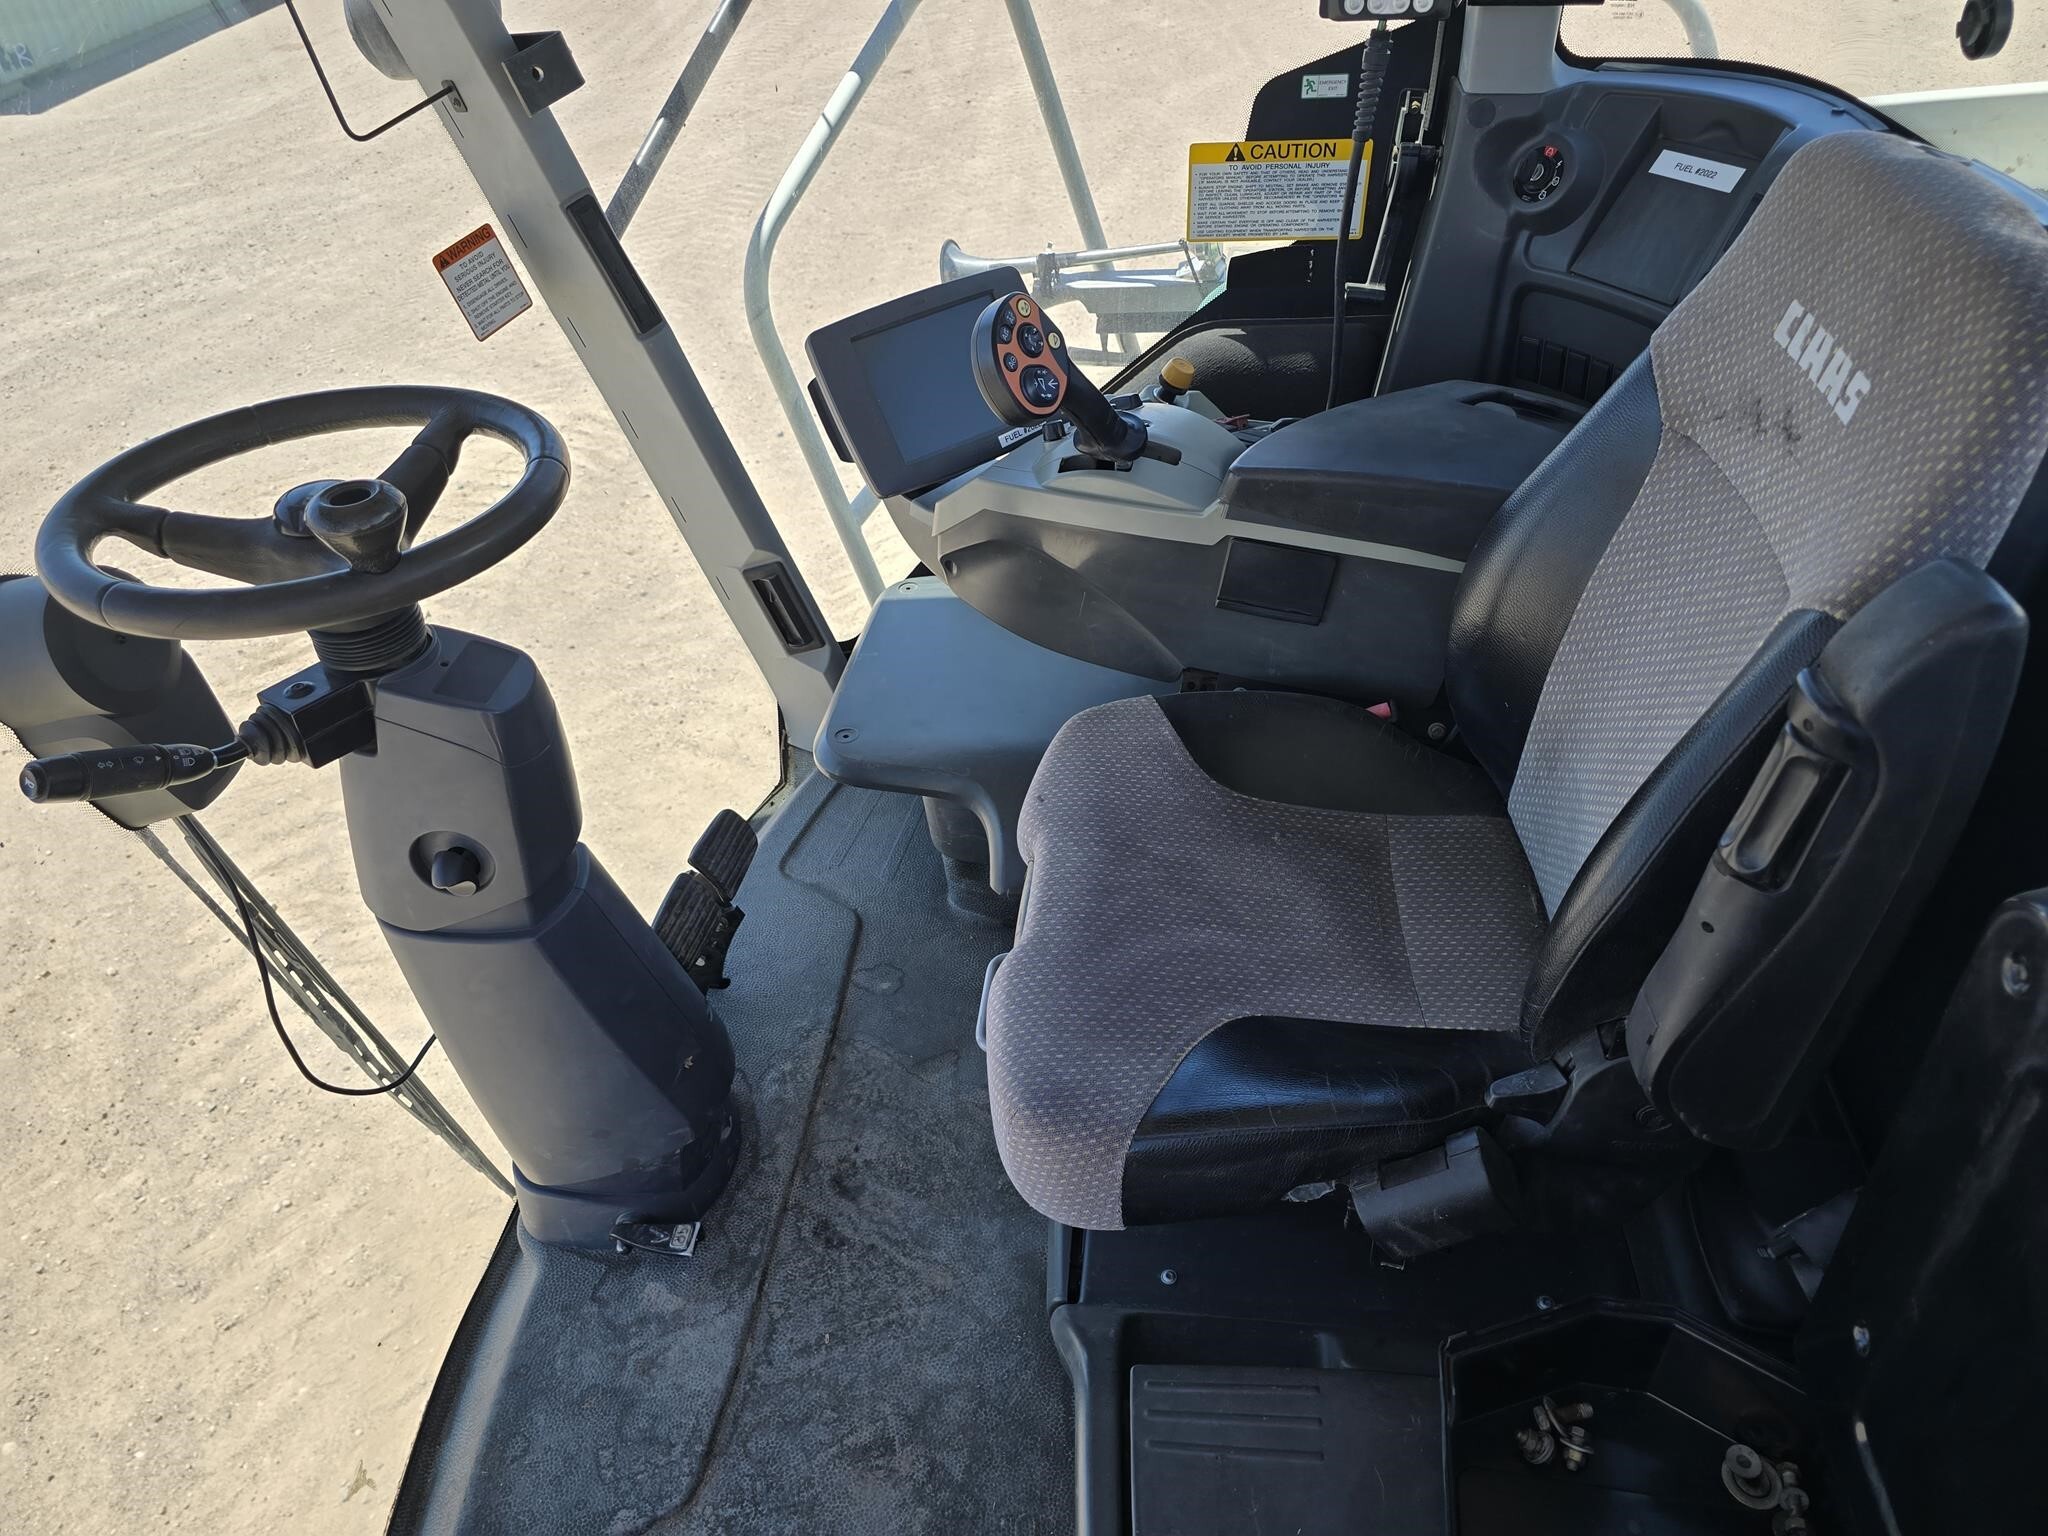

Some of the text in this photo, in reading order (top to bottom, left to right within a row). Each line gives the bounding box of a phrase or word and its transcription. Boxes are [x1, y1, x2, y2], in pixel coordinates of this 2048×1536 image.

[1250, 142, 1337, 160] CAUTION
[1673, 162, 1718, 179] FUEL #2022
[446, 226, 491, 261] WARNING
[454, 251, 496, 282] SERIOUS INJURY
[458, 250, 484, 270] TO AVOID
[456, 258, 503, 293] NEVER SEARCH FOR
[456, 284, 477, 301] DETECTED
[476, 275, 490, 288] METAL
[1773, 299, 1872, 426] CLAAS
[1004, 431, 1023, 443] FUEL
